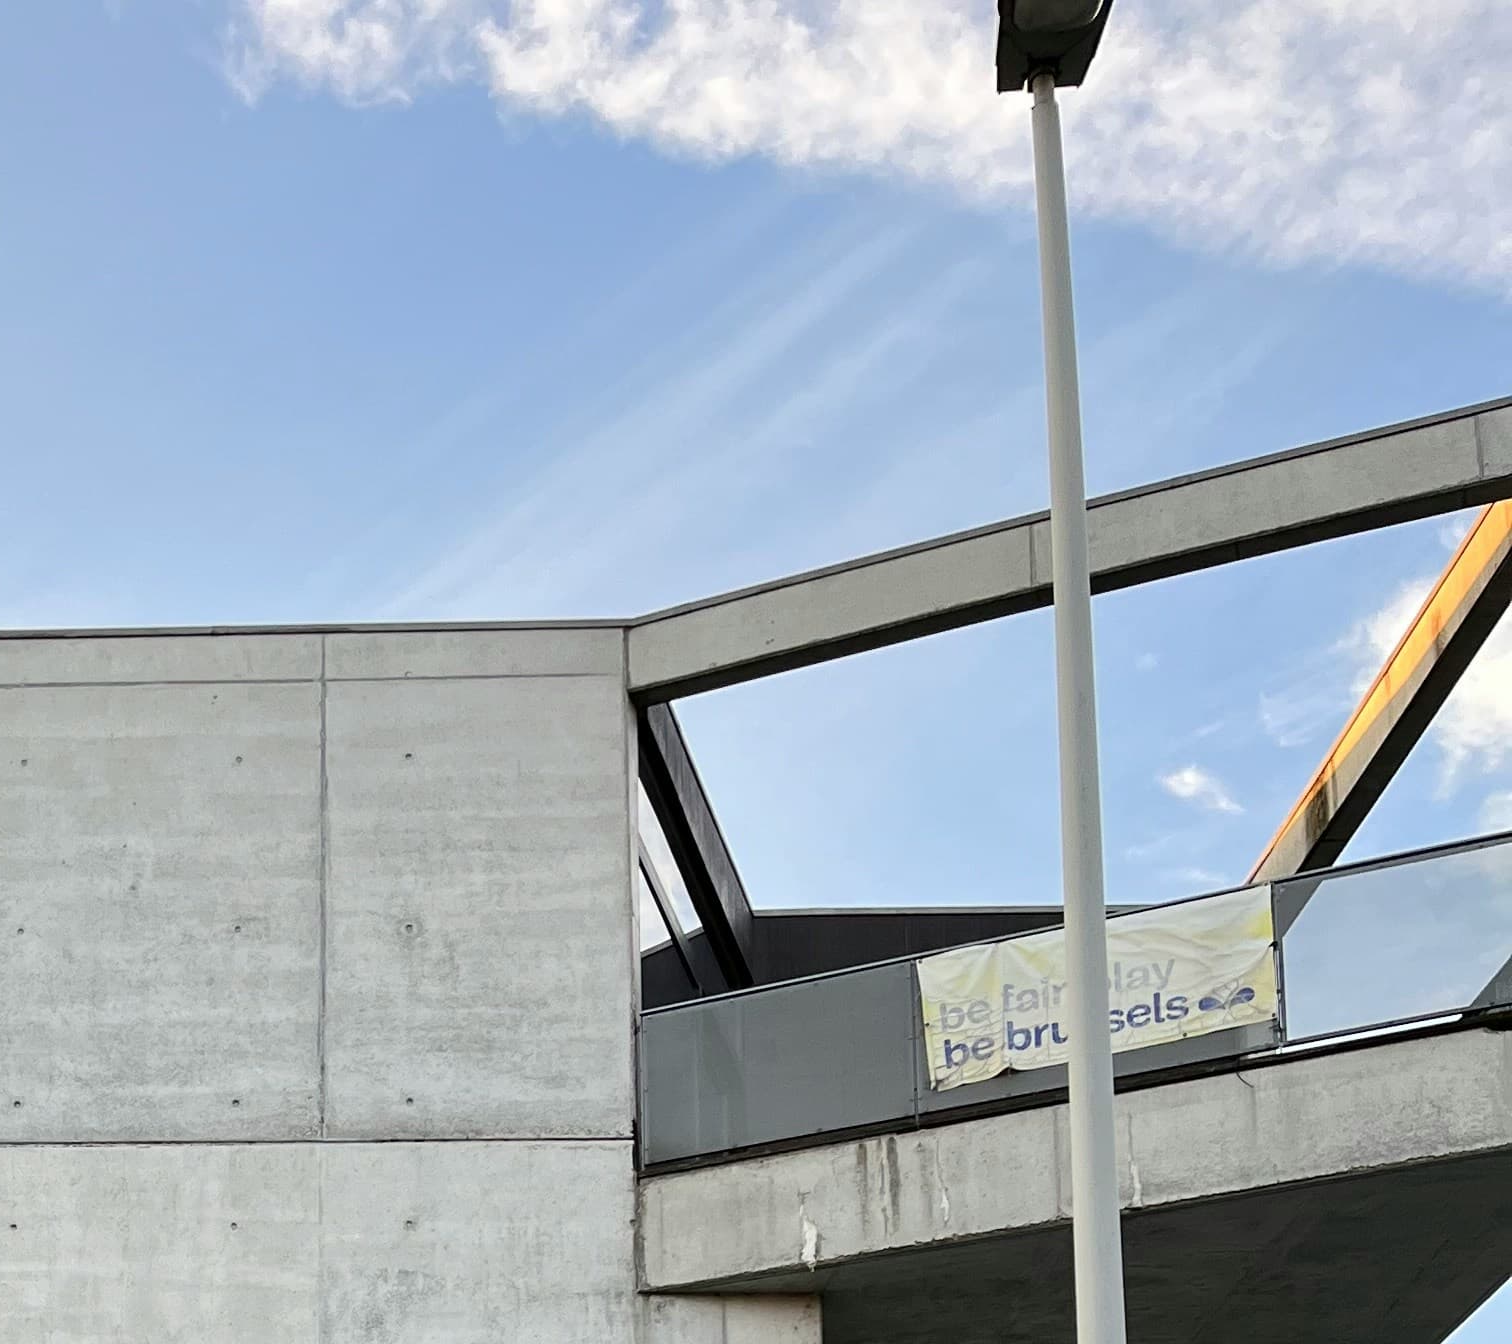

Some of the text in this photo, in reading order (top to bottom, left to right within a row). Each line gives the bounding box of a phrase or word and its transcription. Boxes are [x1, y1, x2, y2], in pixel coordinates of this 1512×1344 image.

[939, 999, 991, 1033] be
[1107, 958, 1176, 993] lay
[944, 991, 1190, 1070] be brusels
